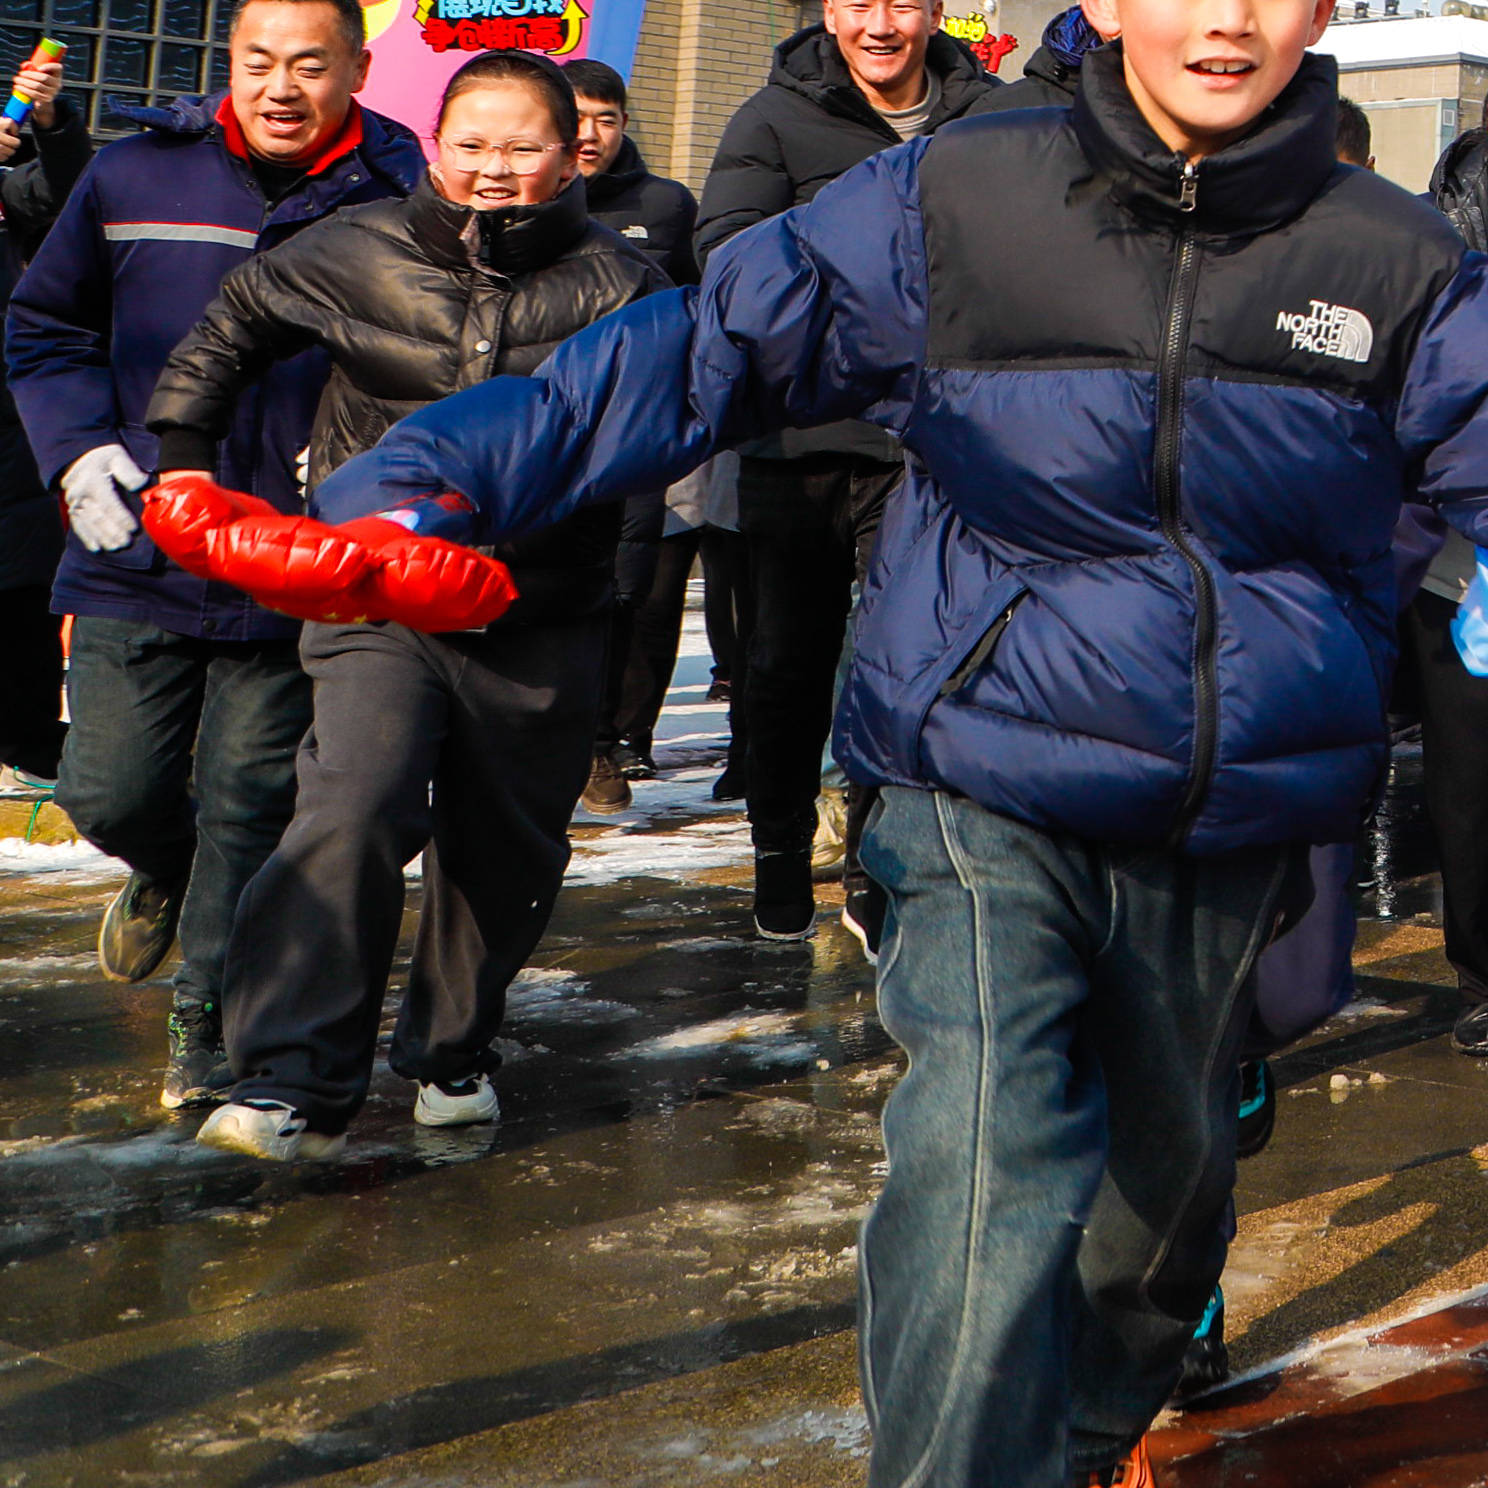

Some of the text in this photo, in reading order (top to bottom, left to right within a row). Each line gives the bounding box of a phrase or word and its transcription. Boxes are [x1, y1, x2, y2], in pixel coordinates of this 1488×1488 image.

[1309, 299, 1349, 324] THE
[1276, 311, 1344, 341] NORTH
[1291, 332, 1341, 356] FACE
